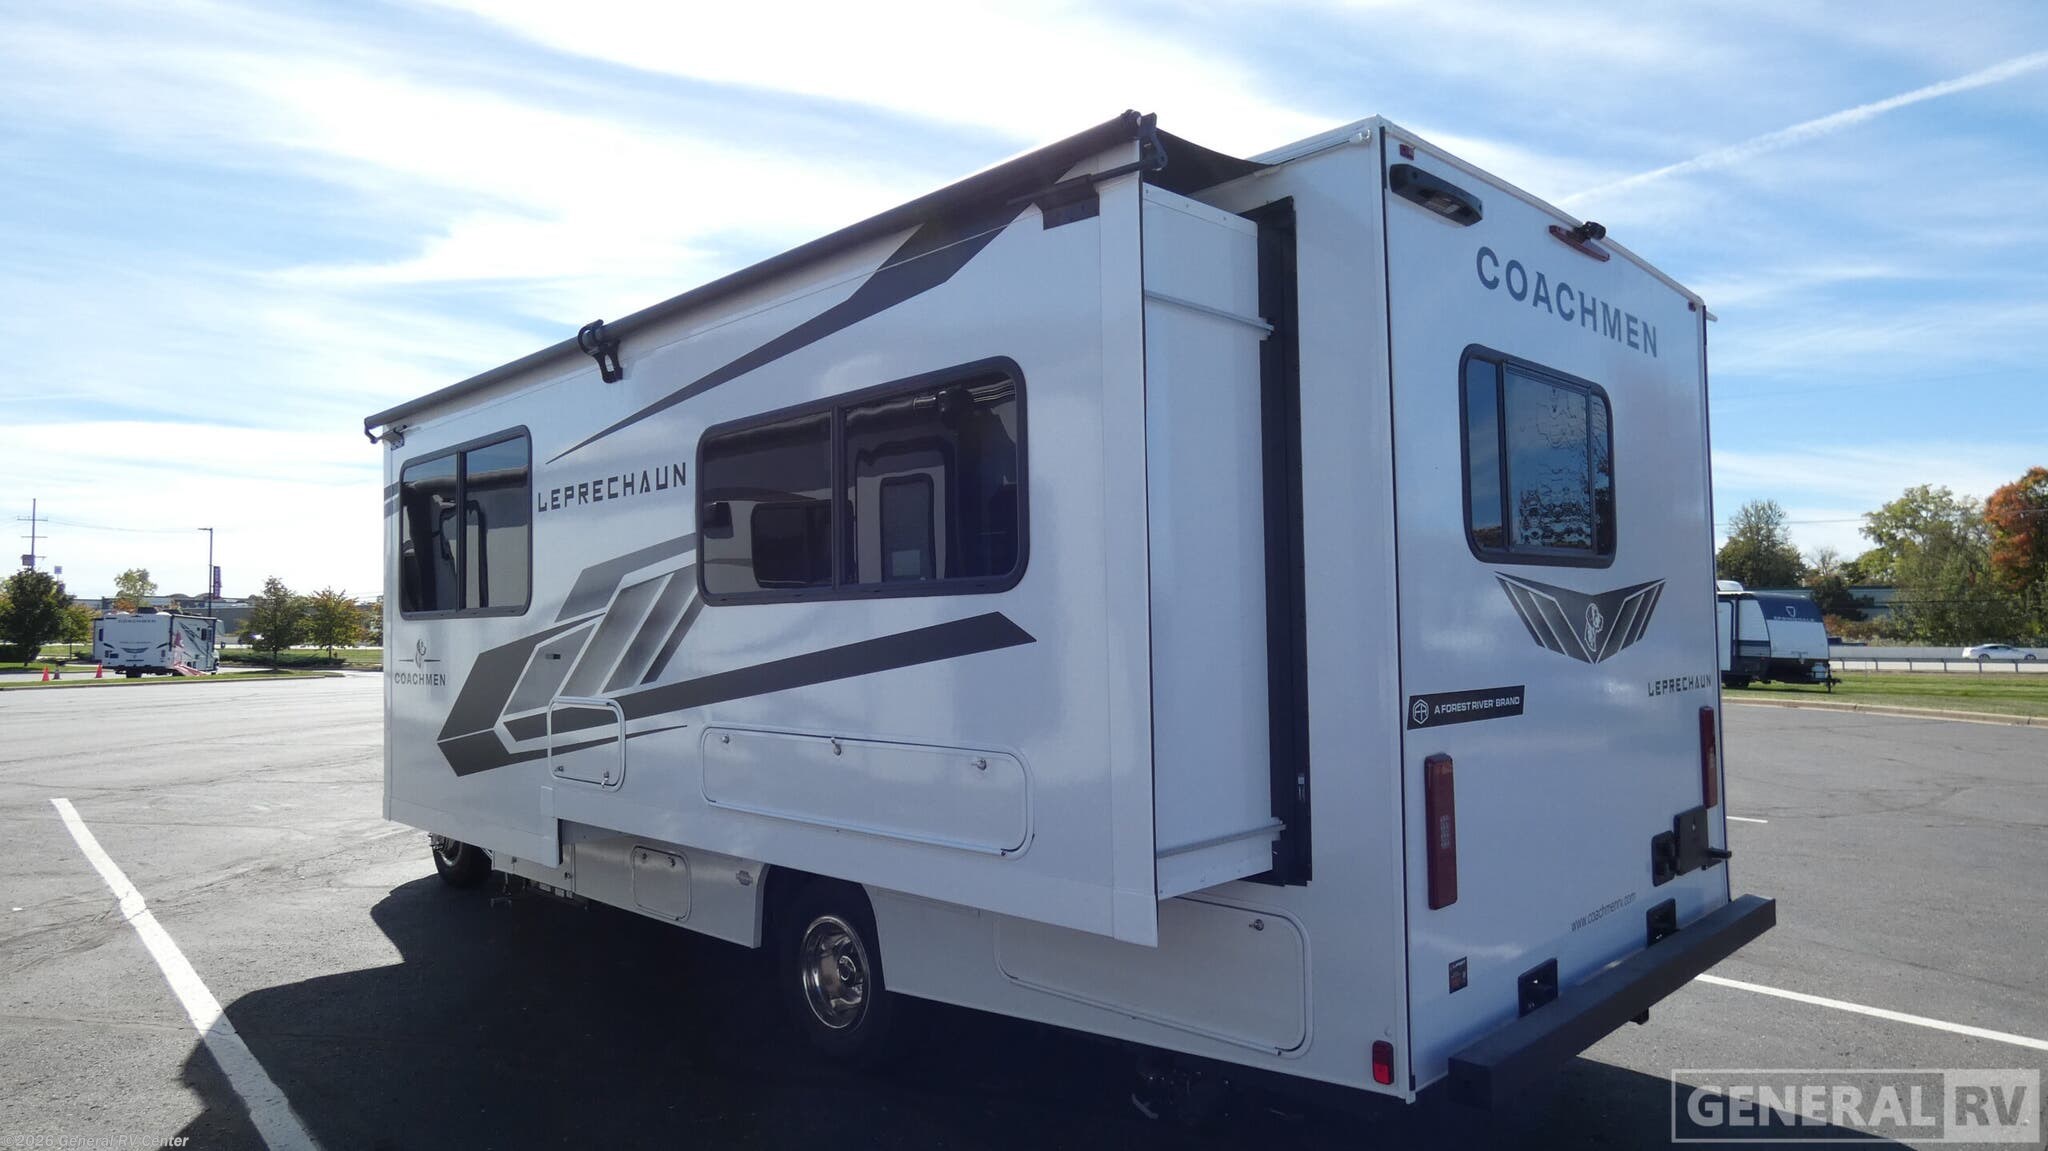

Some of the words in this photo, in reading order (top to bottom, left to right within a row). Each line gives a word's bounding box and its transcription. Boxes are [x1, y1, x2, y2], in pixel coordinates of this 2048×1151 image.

[1476, 246, 1658, 358] COACHMEN
[538, 462, 686, 512] LEPRECHAUN
[394, 672, 446, 686] COACHMEN
[1648, 674, 1711, 697] LEPRECHAUN
[1434, 705, 1440, 714] A
[1441, 702, 1471, 713] FOREST
[1472, 699, 1493, 710] RIVER
[1496, 696, 1520, 707] BRAND
